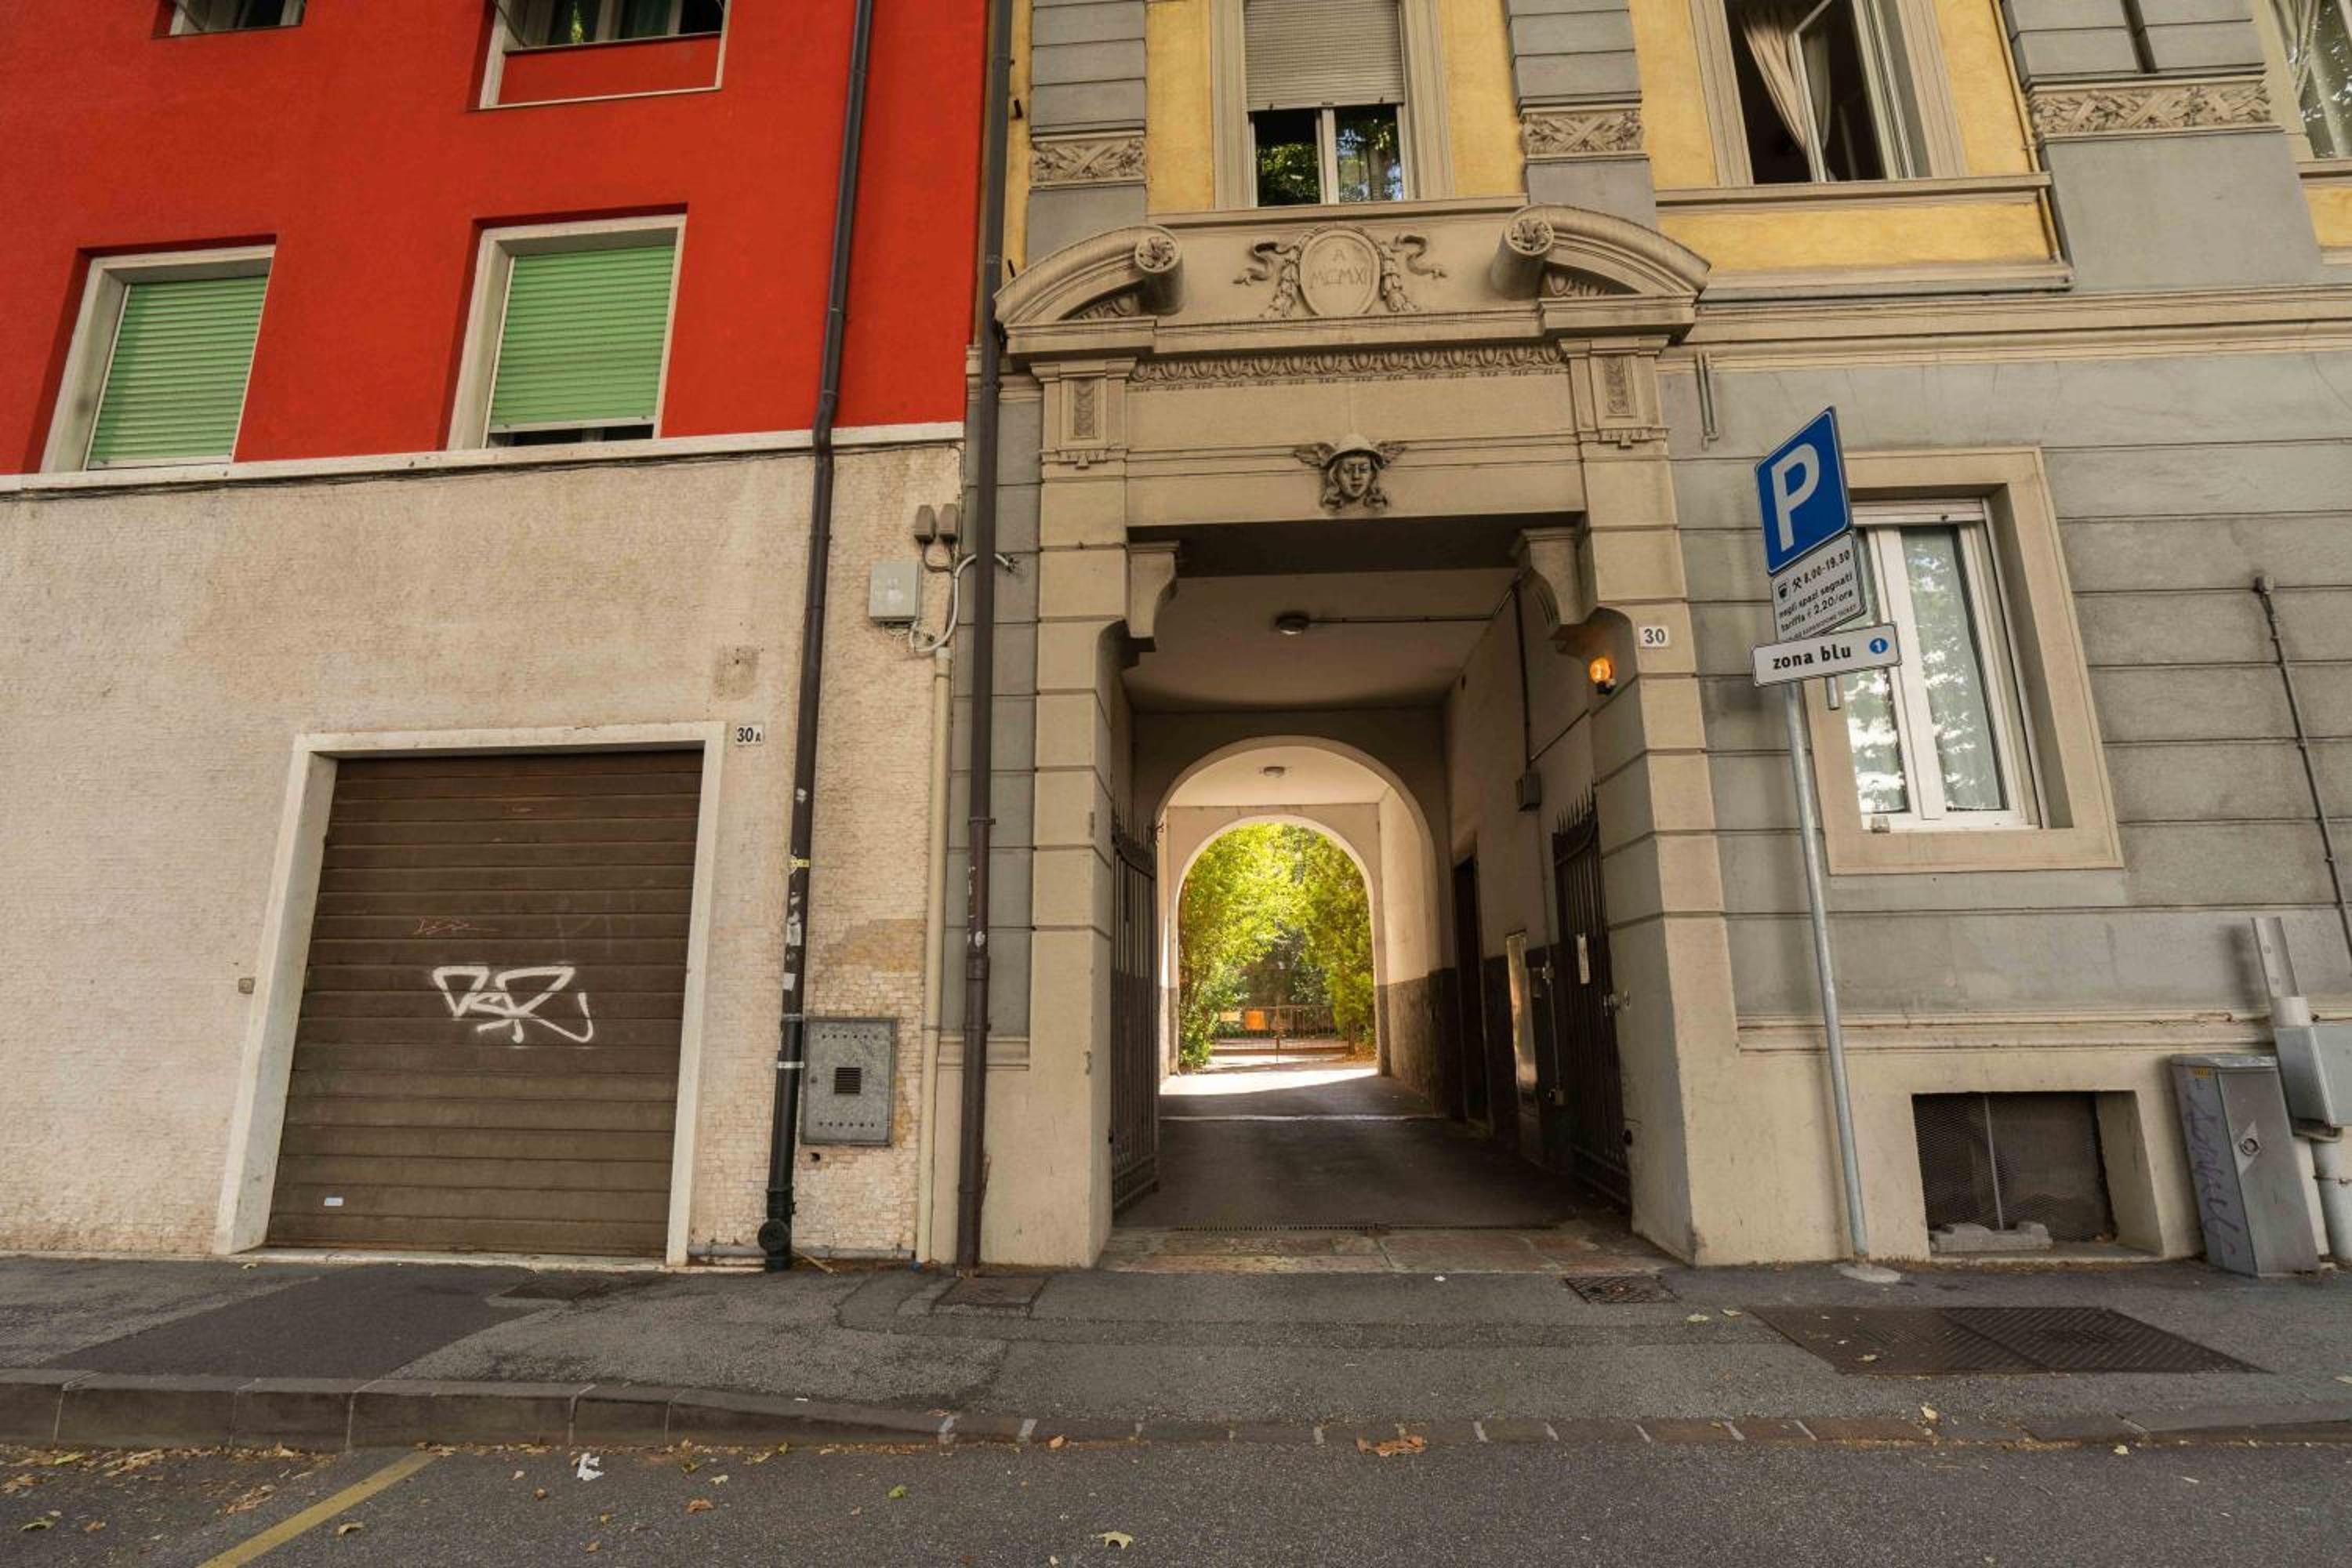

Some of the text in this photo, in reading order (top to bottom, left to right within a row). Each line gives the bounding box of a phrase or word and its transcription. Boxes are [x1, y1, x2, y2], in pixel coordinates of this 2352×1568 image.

[1771, 443, 1820, 553] P
[1820, 572, 1853, 594] segnati
[1644, 628, 1665, 644] 30
[1773, 652, 1814, 670] zona
[1820, 644, 1852, 662] blu
